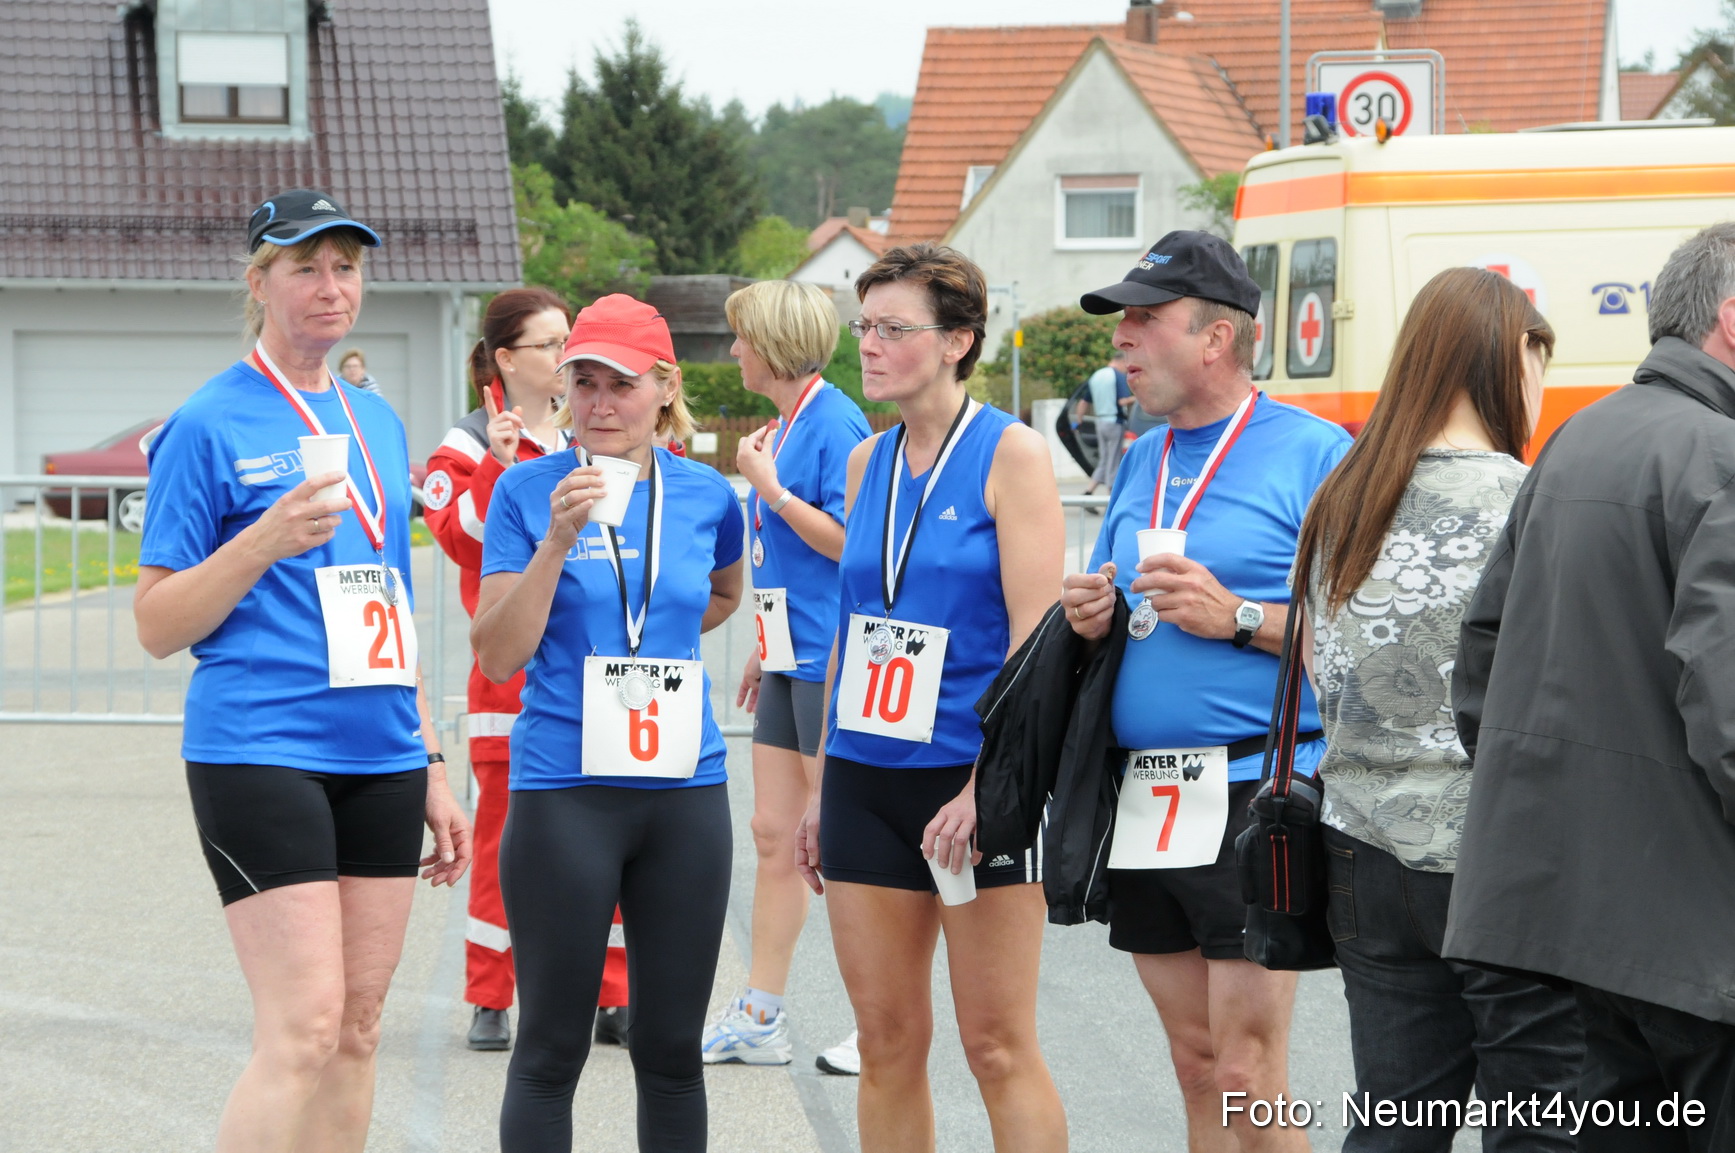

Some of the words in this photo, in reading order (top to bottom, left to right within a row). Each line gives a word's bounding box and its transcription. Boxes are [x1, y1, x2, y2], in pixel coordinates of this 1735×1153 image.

[1354, 91, 1396, 126] 30
[1142, 251, 1173, 265] SPORT
[1639, 281, 1651, 314] 1
[339, 570, 381, 584] MEYE
[340, 585, 382, 595] WERBUN
[363, 600, 405, 670] 21
[862, 656, 914, 724] 10
[628, 697, 659, 762] 6
[1133, 754, 1178, 769] MEYER
[1132, 769, 1180, 781] WERBUNG
[1151, 785, 1181, 852] 7
[988, 859, 1015, 868] adidas
